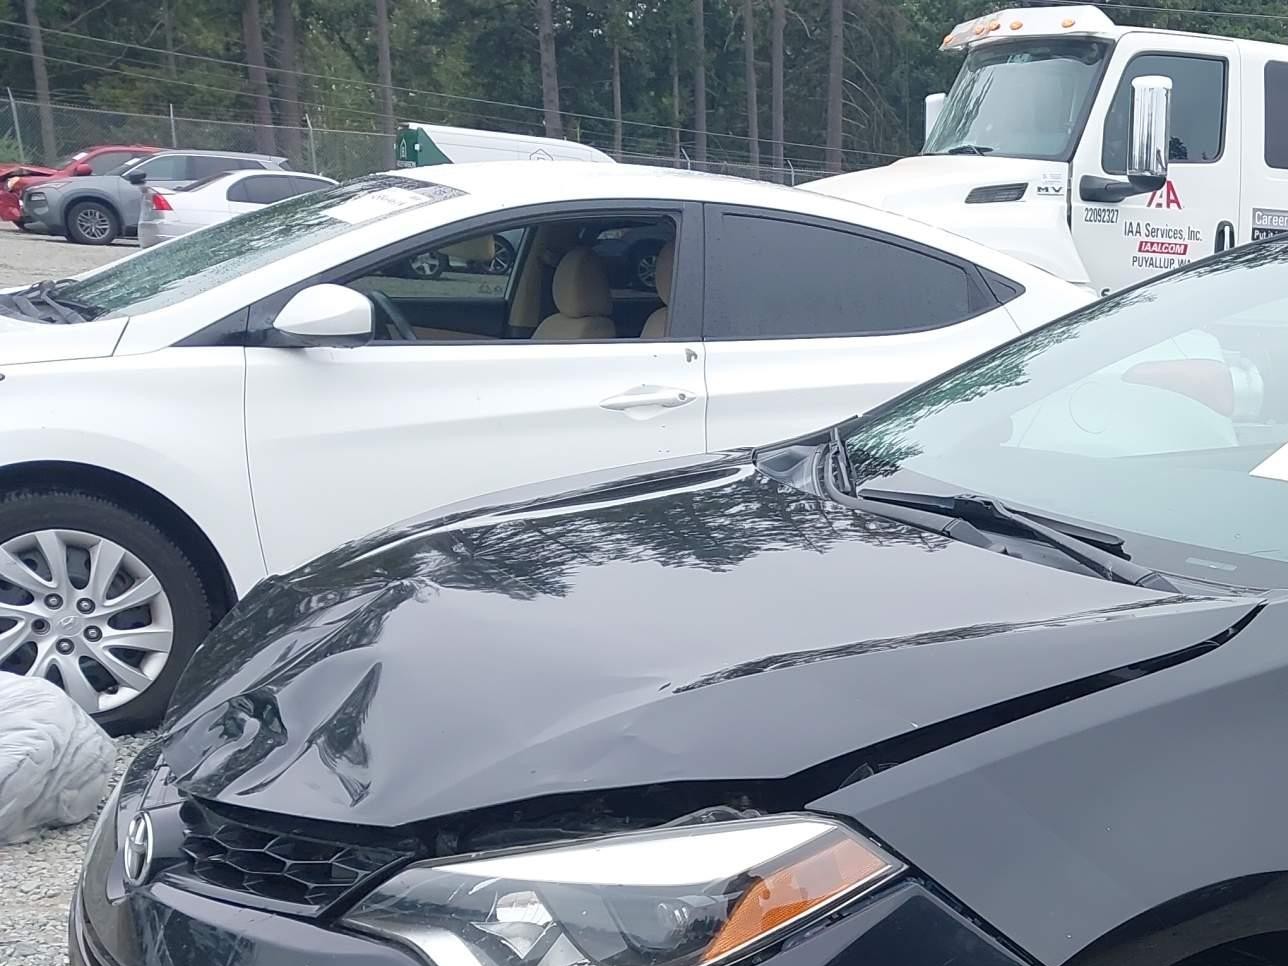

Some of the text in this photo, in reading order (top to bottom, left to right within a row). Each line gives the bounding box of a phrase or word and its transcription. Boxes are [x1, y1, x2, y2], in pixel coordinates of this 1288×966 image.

[1084, 207, 1119, 223] 22092327
[1255, 211, 1288, 226] Career
[1124, 220, 1203, 241] IAA Services, Inc.
